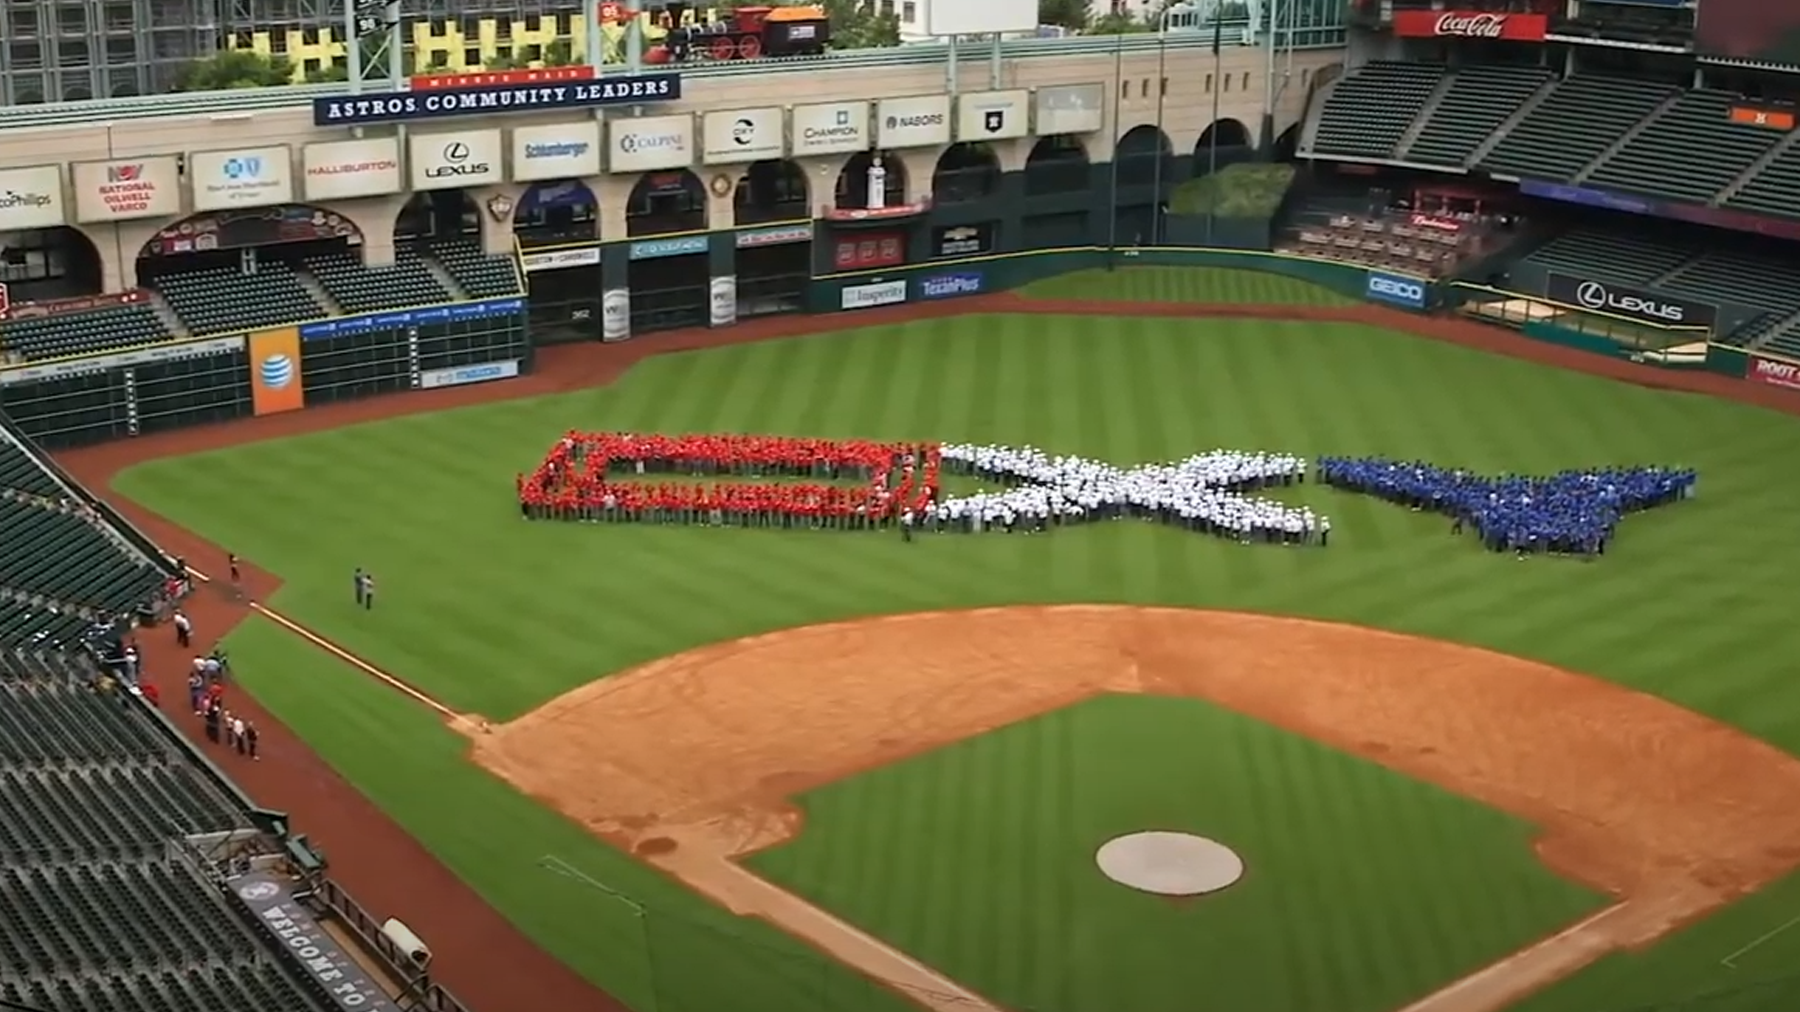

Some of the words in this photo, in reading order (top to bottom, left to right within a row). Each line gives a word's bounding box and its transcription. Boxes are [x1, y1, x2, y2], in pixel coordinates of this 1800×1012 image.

[328, 96, 417, 119] ASTROS
[426, 87, 567, 112] COMMUNITY
[575, 79, 670, 100] LEADERS
[899, 113, 944, 129] NABORS
[804, 125, 859, 142] CHAMPION
[525, 141, 590, 160] Schlumberger
[307, 159, 397, 177] HALLIBURTON
[425, 162, 490, 179] LEXUS
[99, 181, 156, 196] NATIONAL
[103, 192, 152, 205] OILWELL
[110, 201, 149, 213] VARCO
[923, 276, 980, 296] TexanPlus
[1370, 277, 1423, 302] GEICO
[1608, 292, 1684, 321] LEXUS
[261, 905, 344, 983] WELCOME
[333, 982, 366, 1006] TO
